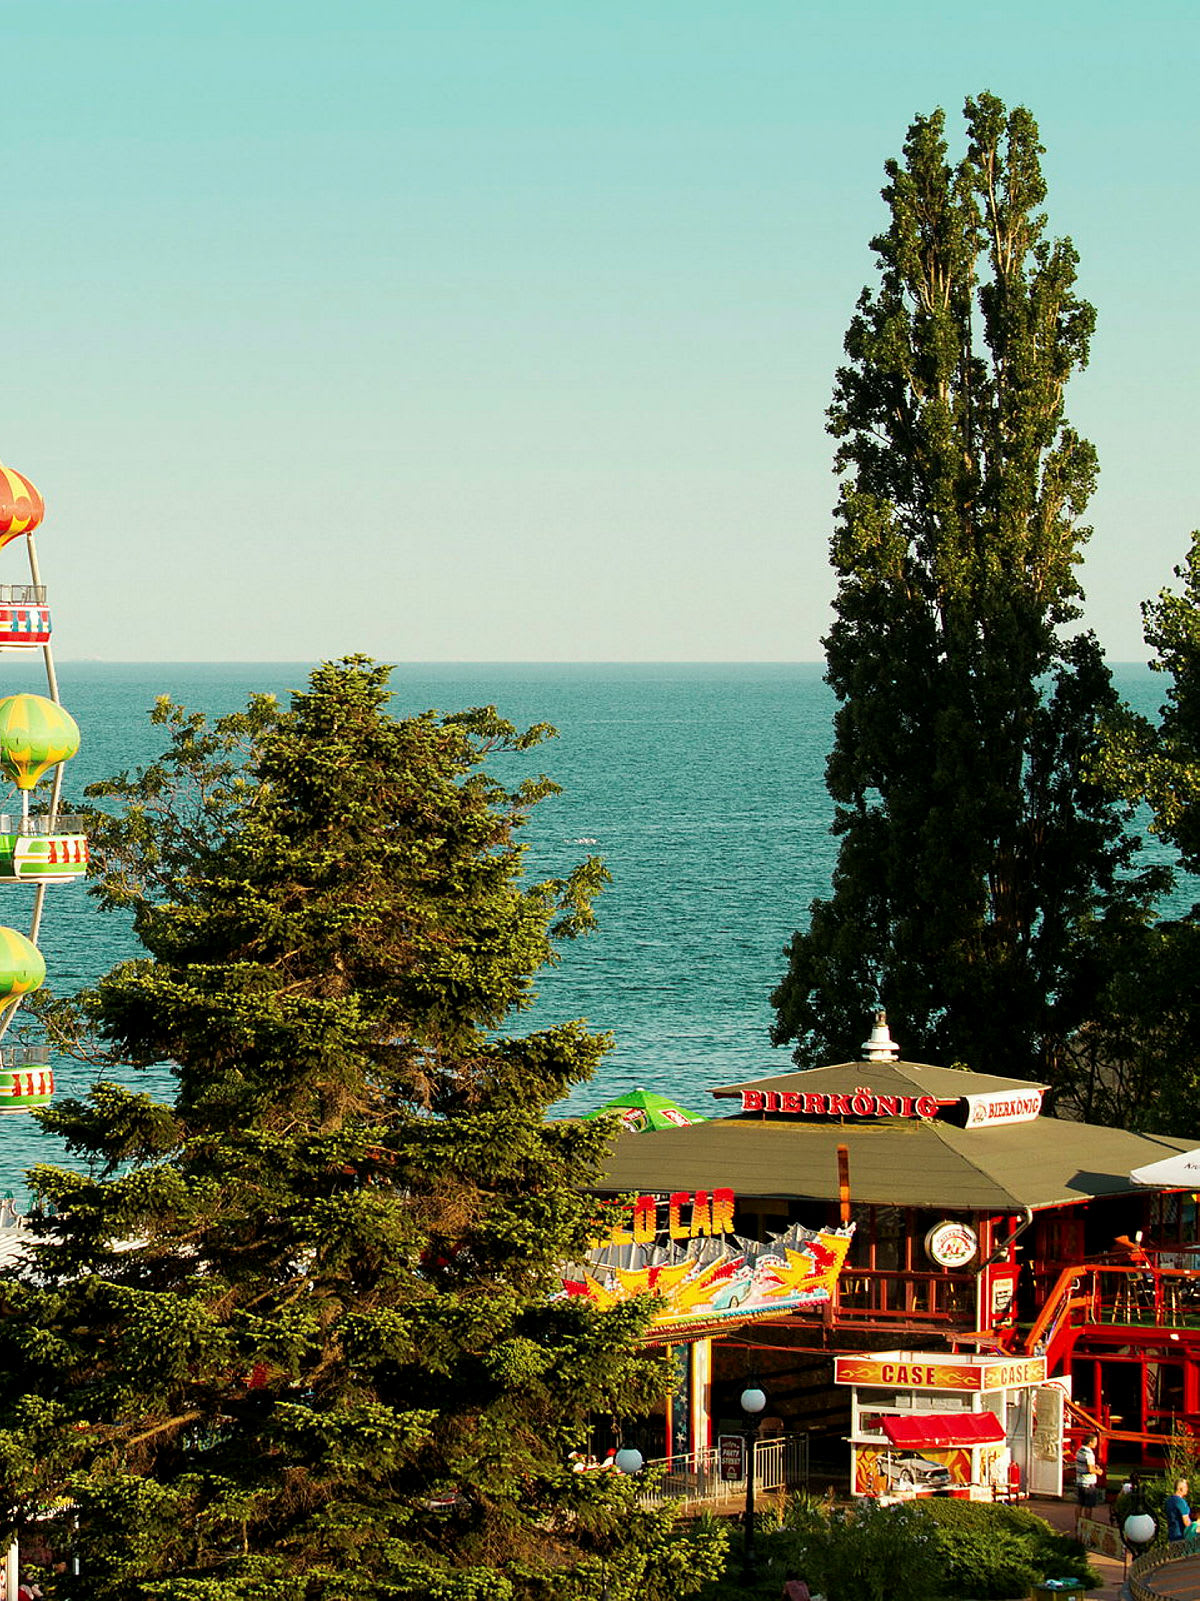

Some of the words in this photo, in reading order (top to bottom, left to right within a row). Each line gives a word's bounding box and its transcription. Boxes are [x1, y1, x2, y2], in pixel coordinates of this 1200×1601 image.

[740, 1086, 939, 1118] BIERKÖNIG
[988, 1097, 1039, 1118] BIERKÖNIG
[669, 1187, 736, 1240] CAR
[881, 1364, 936, 1385] CASE
[1000, 1363, 1029, 1386] CASE
